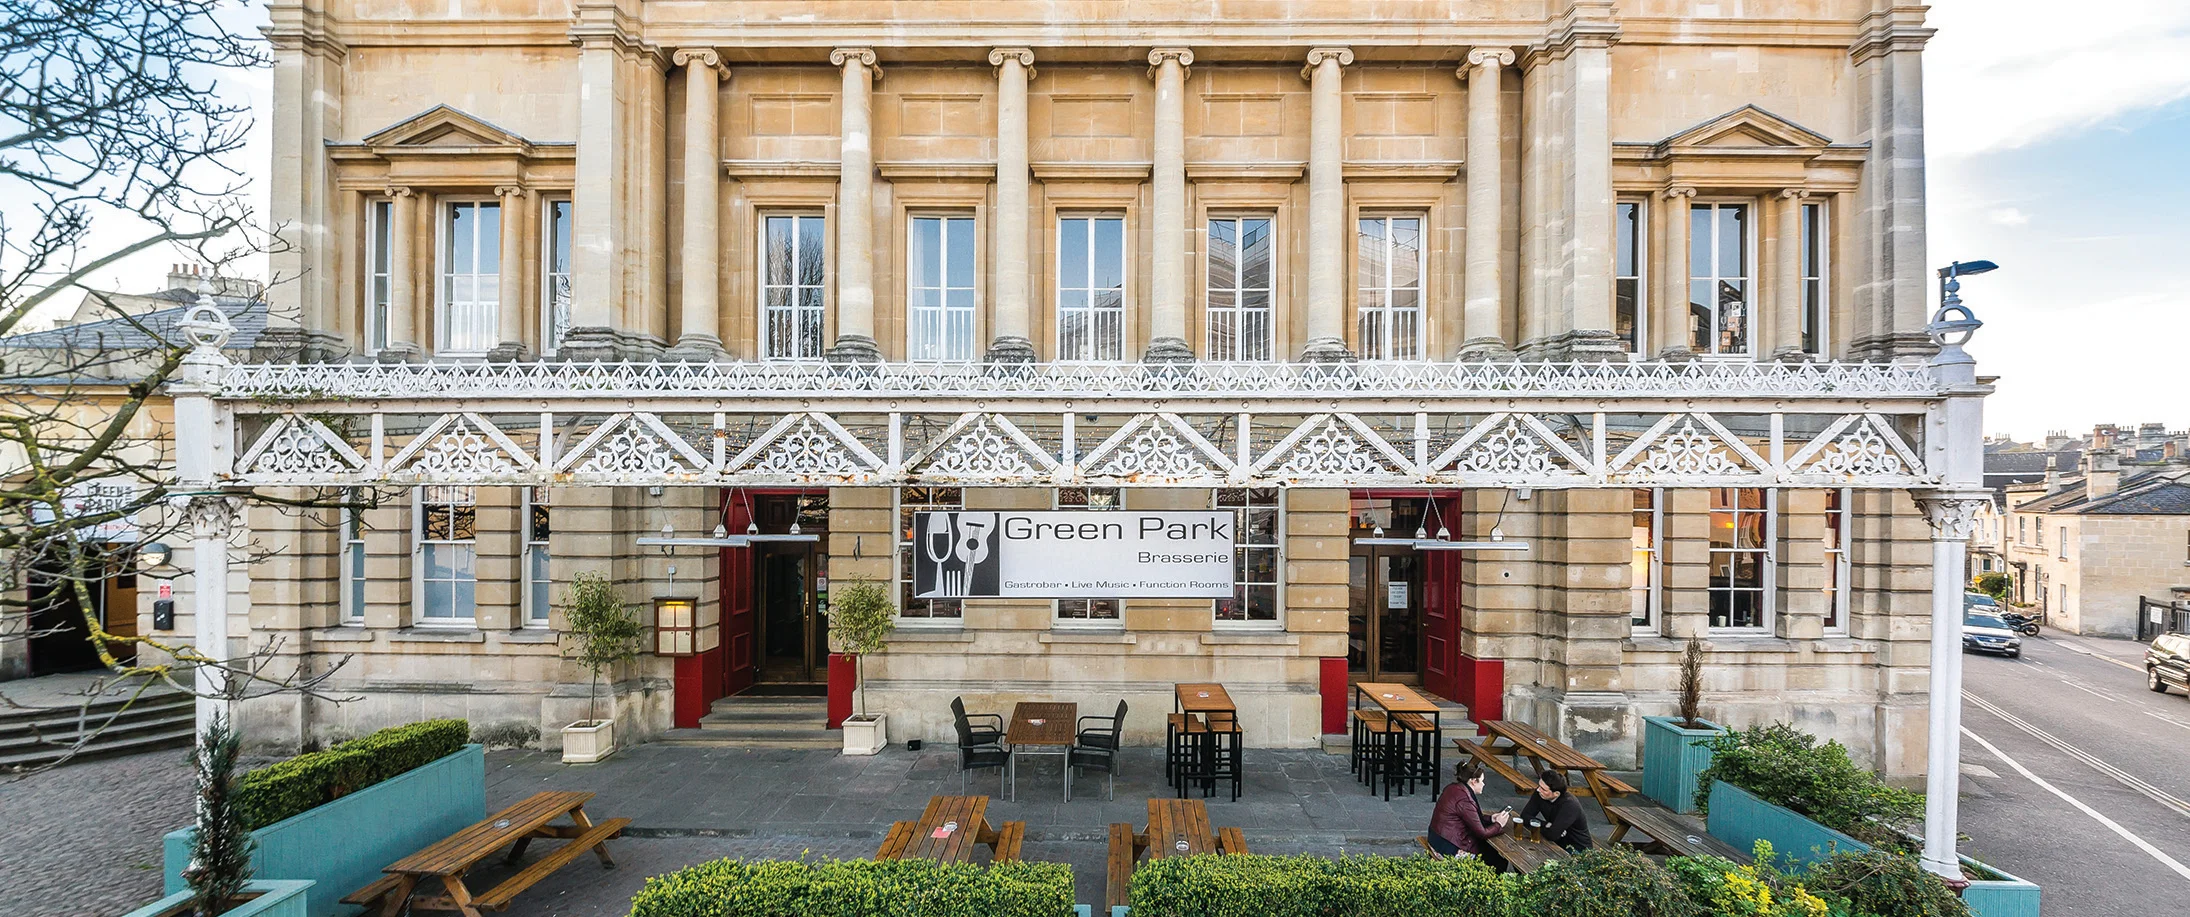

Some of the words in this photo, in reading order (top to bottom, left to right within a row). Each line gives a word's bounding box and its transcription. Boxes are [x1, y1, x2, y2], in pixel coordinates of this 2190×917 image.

[1004, 516, 1123, 540] Green
[1139, 516, 1230, 540] Park
[1138, 551, 1229, 564] Brasserie
[1004, 580, 1062, 589] Gastrobar
[1071, 580, 1093, 589] Live
[1096, 580, 1130, 589] Music
[1139, 580, 1187, 589] Function
[1189, 580, 1230, 589] Rooms
